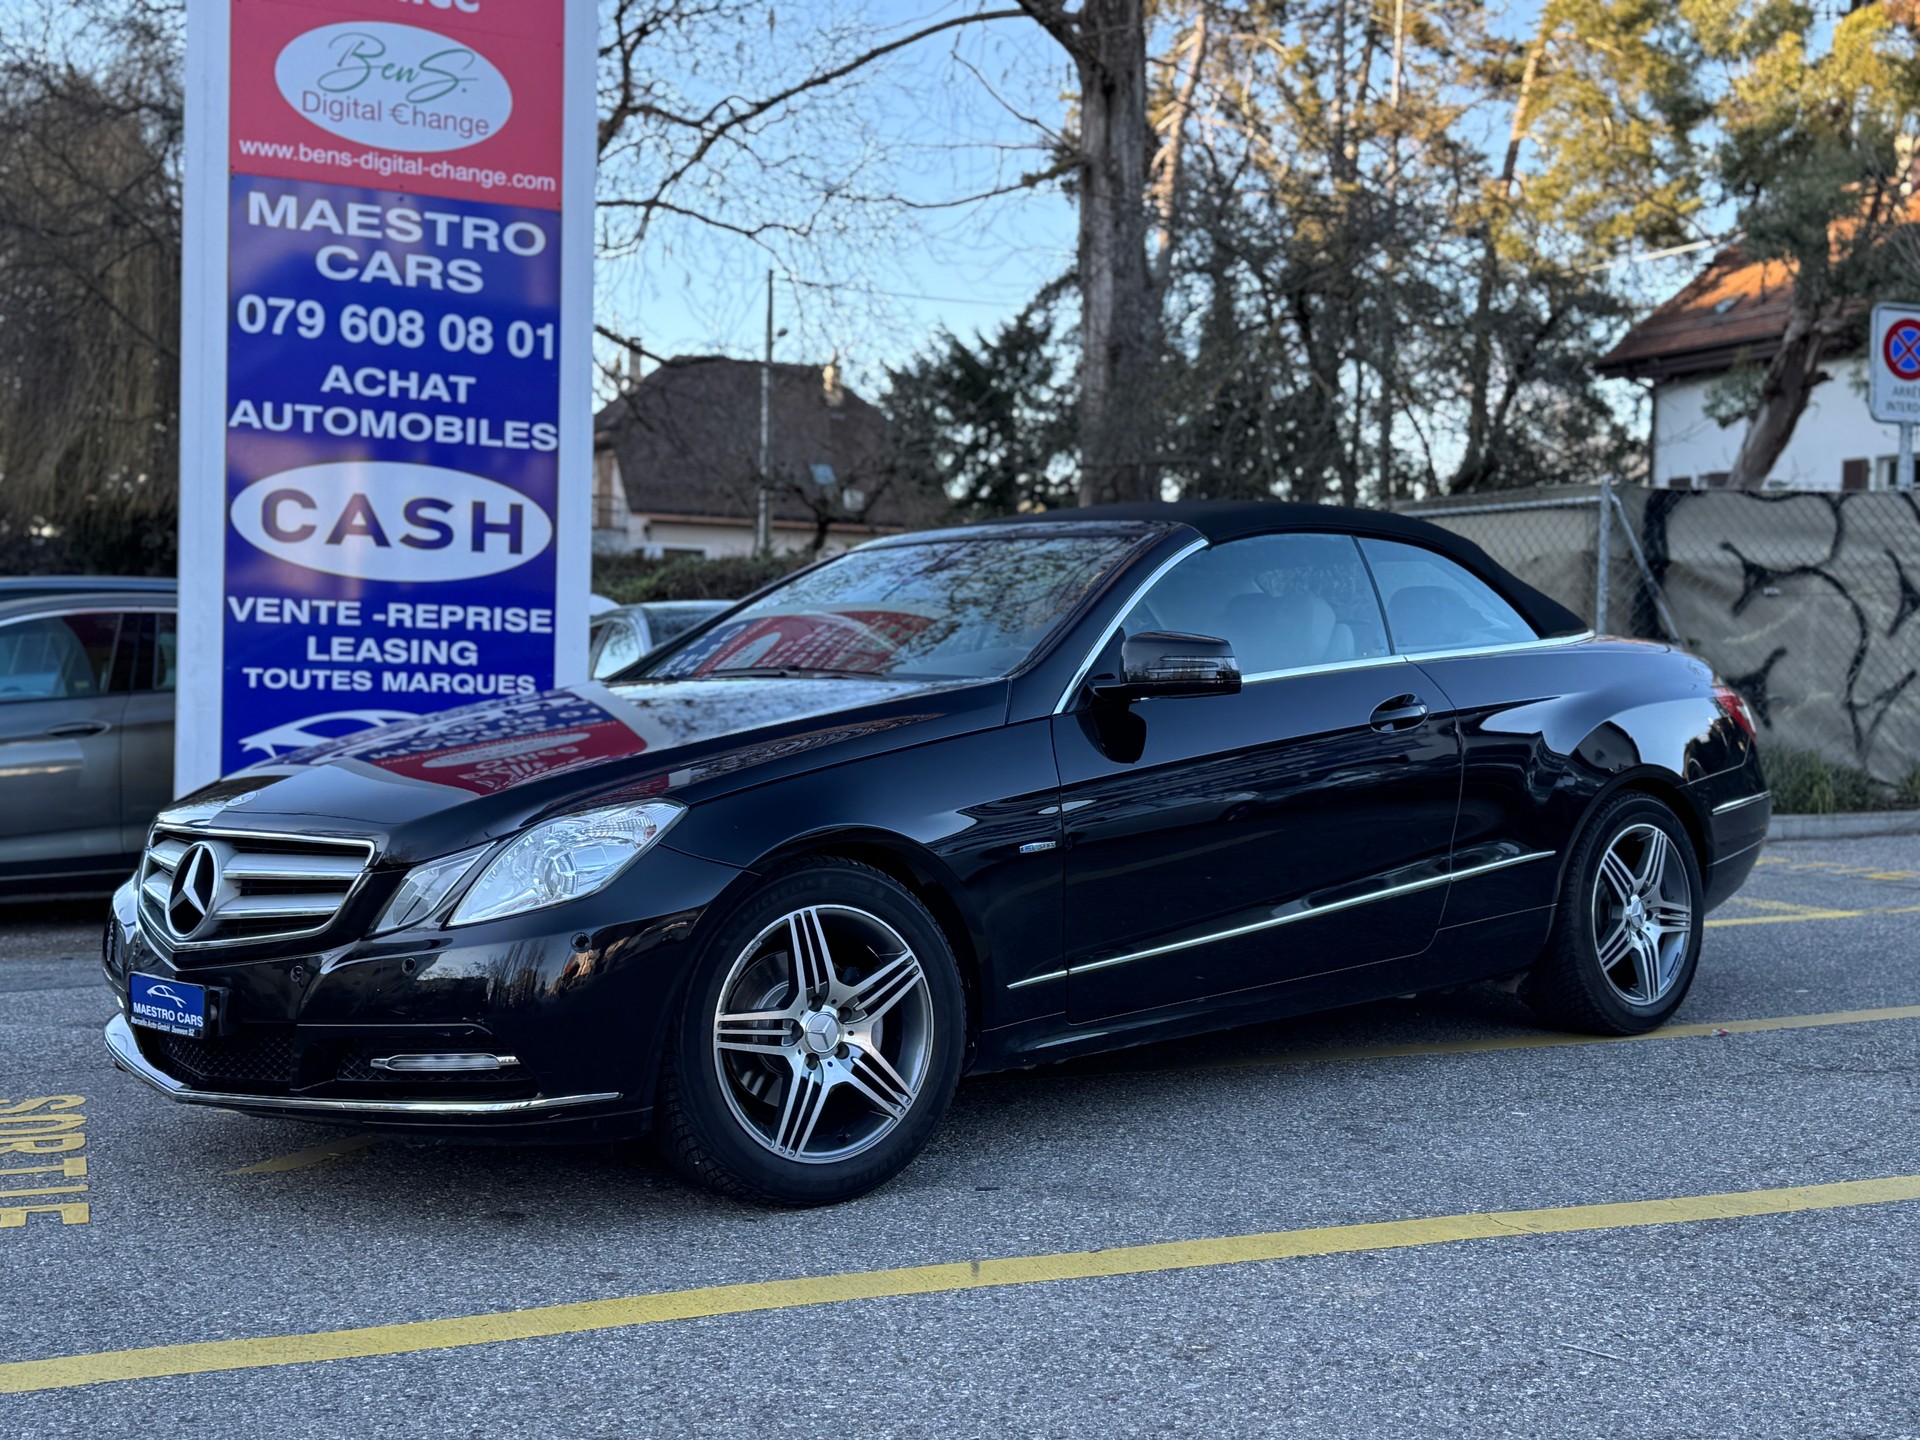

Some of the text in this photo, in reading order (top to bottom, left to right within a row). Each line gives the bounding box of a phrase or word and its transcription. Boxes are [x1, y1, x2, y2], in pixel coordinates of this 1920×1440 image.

[302, 90, 382, 122] Digital
[239, 139, 555, 192] www.bens-digital-change.com
[248, 191, 546, 257] MAESTRO
[315, 245, 484, 294] CARS
[237, 294, 554, 360] 079 608 08 01
[321, 365, 476, 404] ACHAT
[228, 400, 559, 452] AUTOMOBILES
[1886, 401, 1920, 413] INTERD
[260, 488, 524, 555] CASH
[227, 596, 553, 634] VENTE -REPRISE
[306, 636, 479, 666] LEASING
[242, 667, 536, 696] TOUTES MARQUES
[133, 1002, 203, 1027] MAESTRO CARS
[0, 1095, 90, 1228] SORTIE
